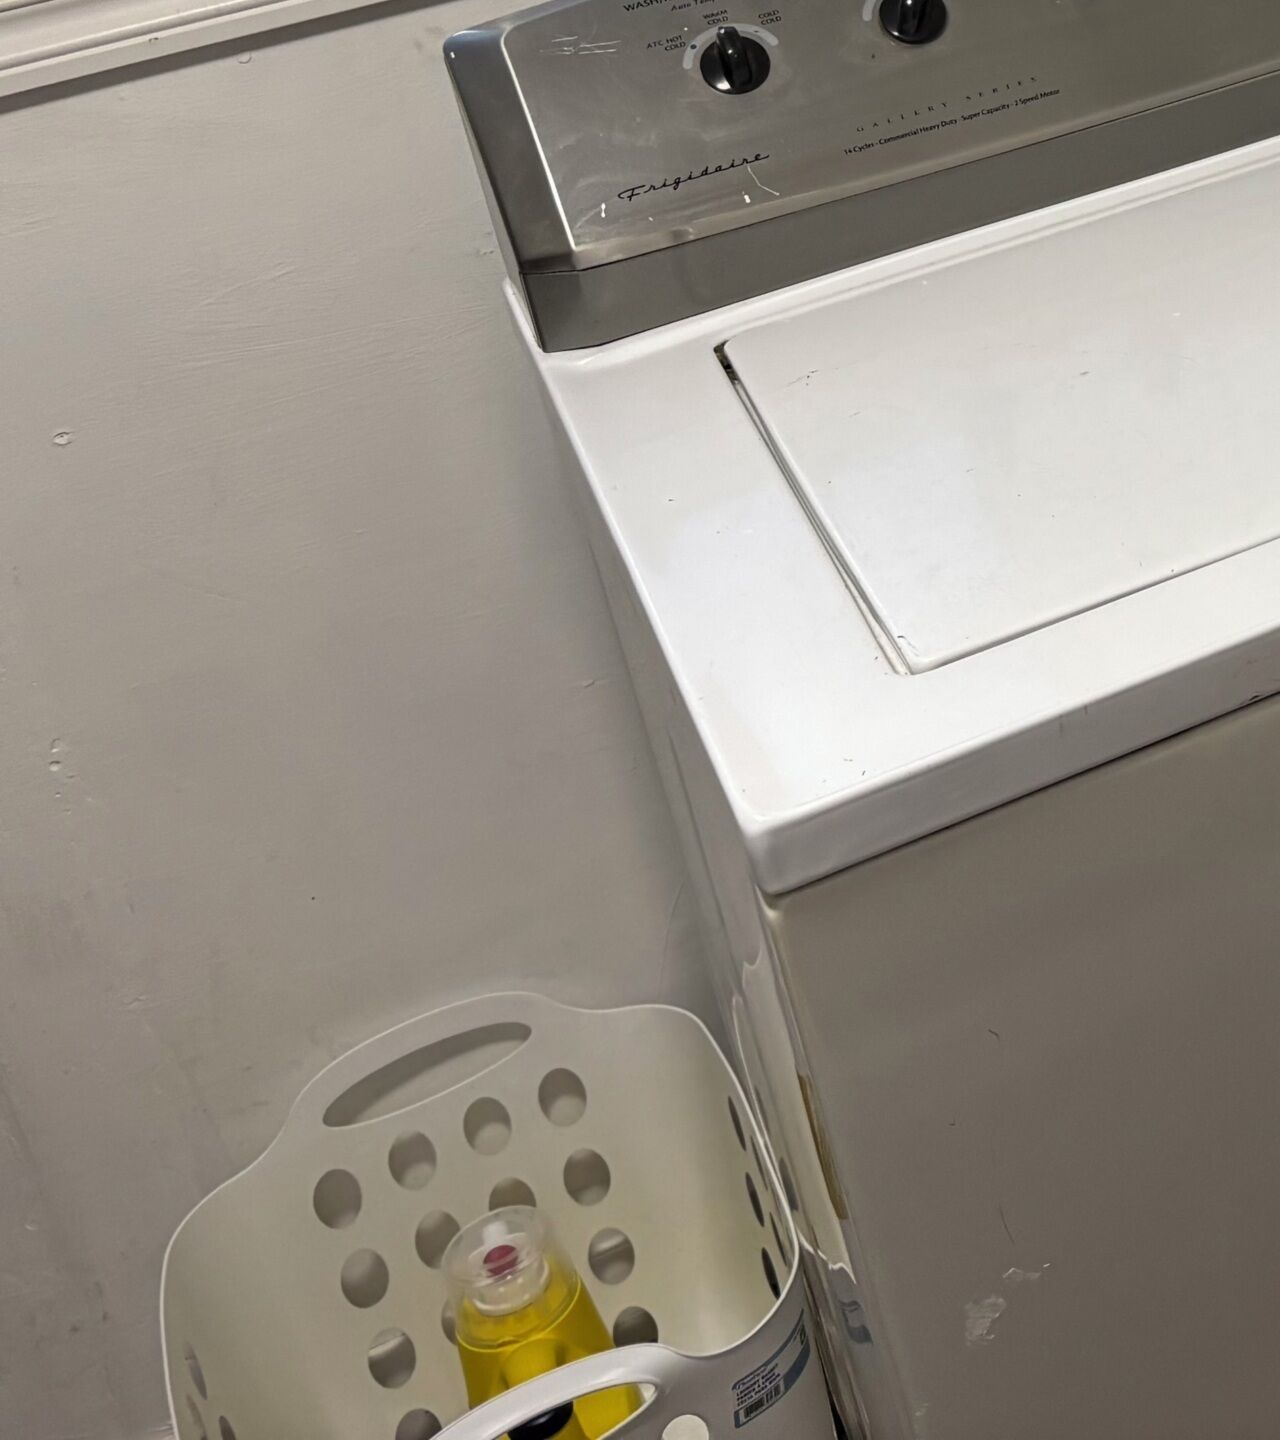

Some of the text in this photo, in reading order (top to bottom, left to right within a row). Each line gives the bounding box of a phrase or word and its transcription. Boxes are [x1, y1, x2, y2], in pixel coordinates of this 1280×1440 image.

[670, 2, 692, 12] Auto
[702, 9, 728, 20] WARM
[758, 9, 780, 20] COLD
[707, 16, 729, 26] COLD
[760, 15, 782, 26] COLD
[646, 40, 664, 50] ATC
[664, 41, 687, 52] COLD
[853, 142, 874, 153] Cycles
[878, 128, 920, 145] Commercial
[920, 123, 940, 134] Heavy
[941, 119, 957, 128] Duty
[961, 111, 981, 121] Super
[981, 103, 1010, 116] Capacity
[1019, 93, 1039, 105] Speed
[617, 152, 770, 202] Frigidaire
